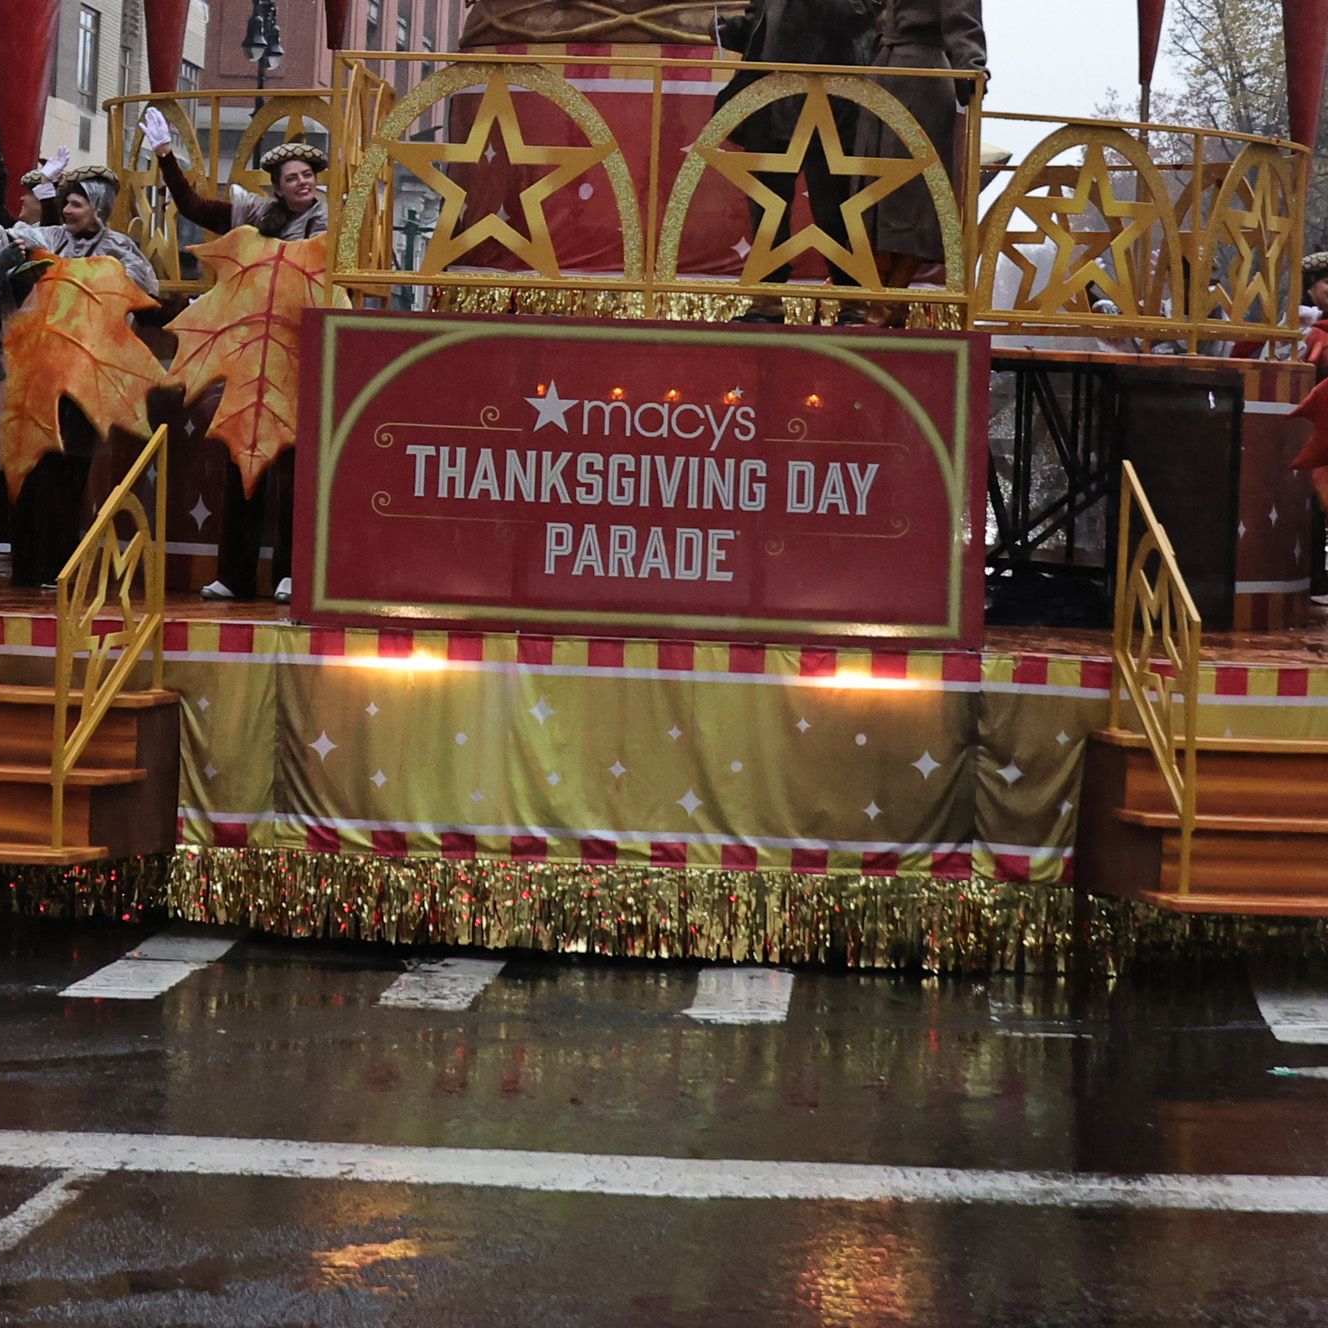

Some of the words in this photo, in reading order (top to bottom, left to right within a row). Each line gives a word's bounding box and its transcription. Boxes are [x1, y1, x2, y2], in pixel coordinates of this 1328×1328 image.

[405, 444, 767, 512] THANKSGIVING
[785, 459, 880, 516] DAY
[543, 521, 736, 583] PARADE
